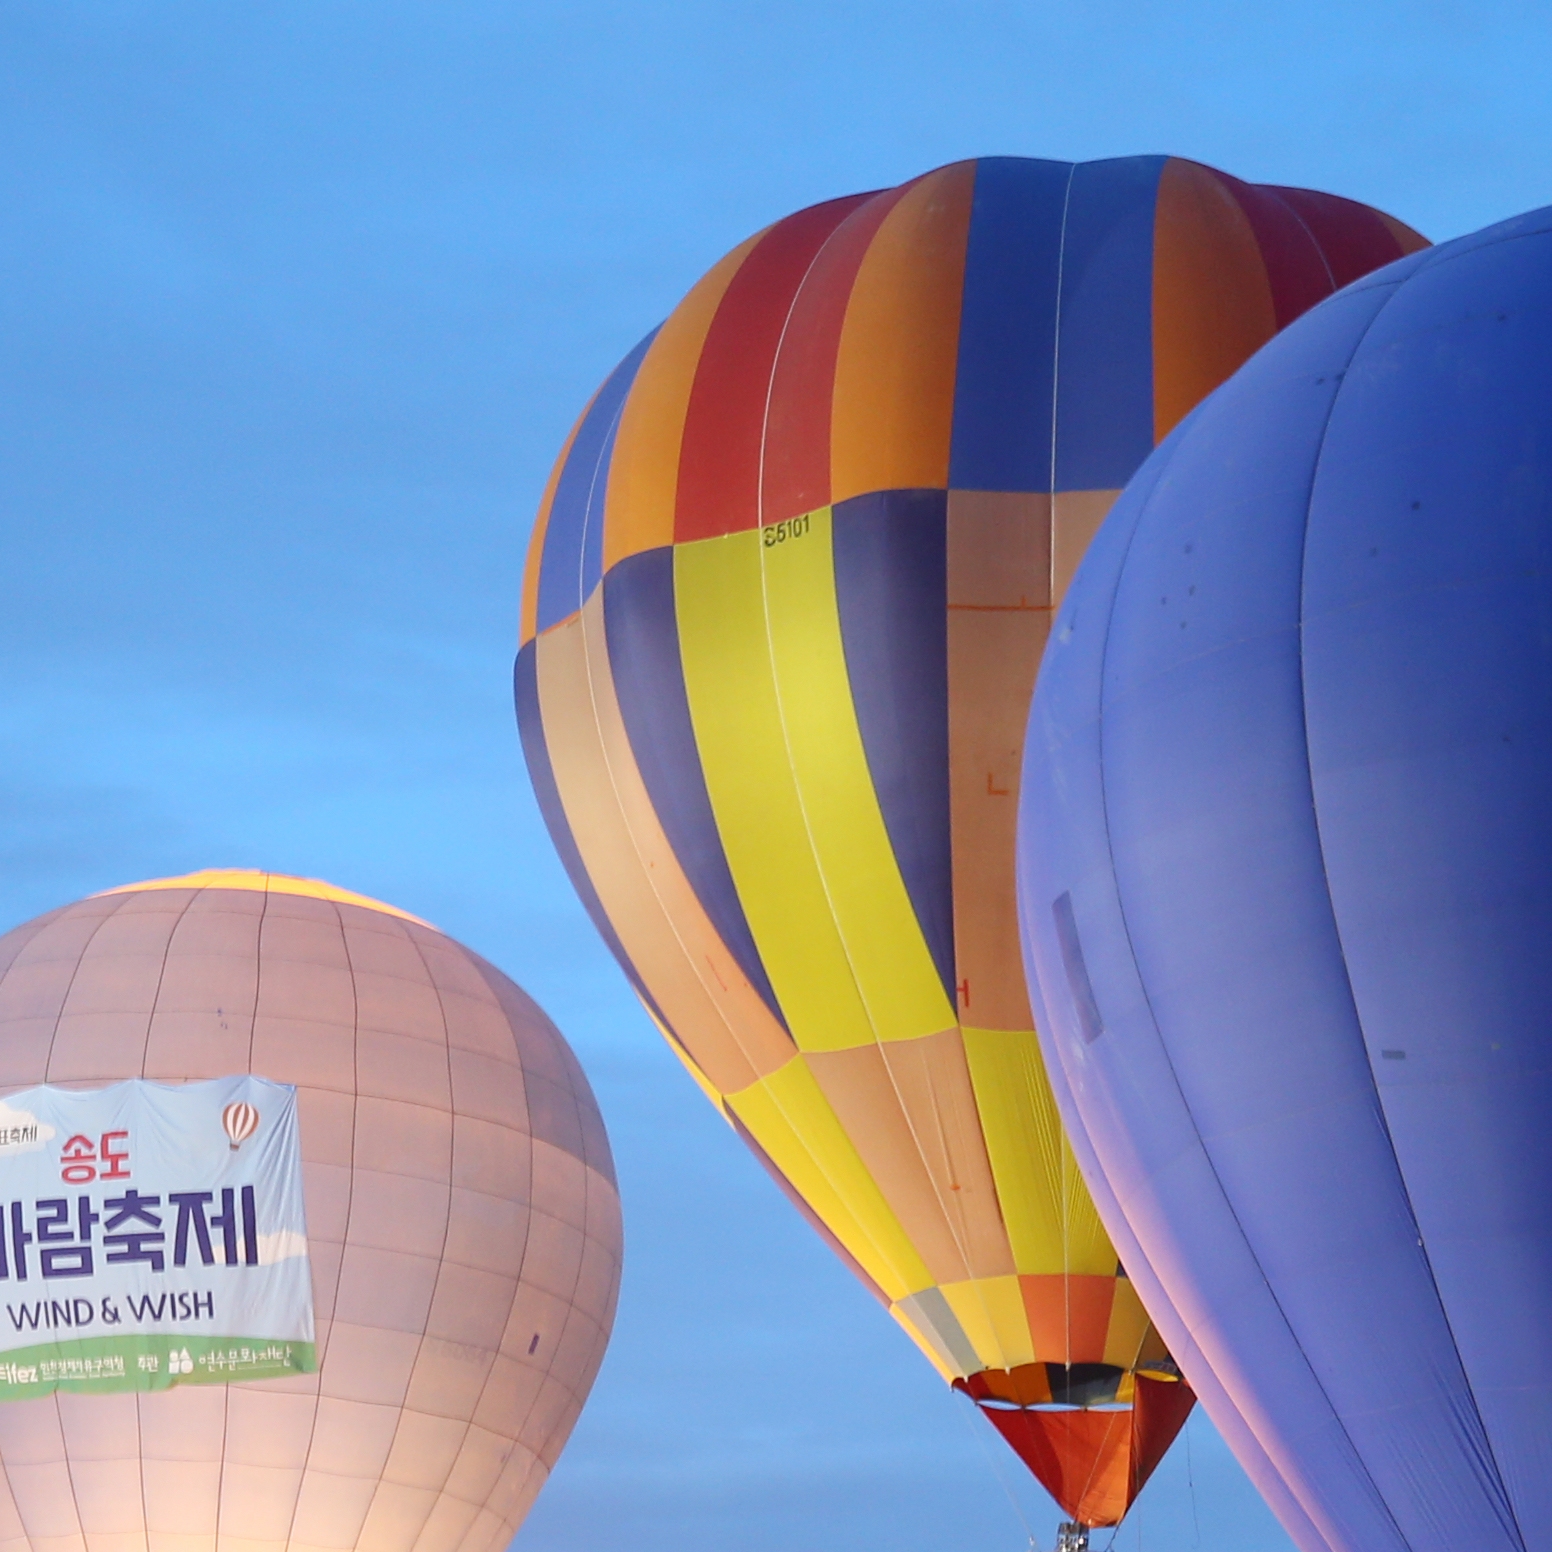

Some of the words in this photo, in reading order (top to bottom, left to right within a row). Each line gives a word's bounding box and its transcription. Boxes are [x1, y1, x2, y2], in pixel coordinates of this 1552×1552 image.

[764, 514, 810, 547] S5101
[60, 1130, 130, 1184] 송도
[6, 1299, 94, 1332] WIND
[100, 1296, 121, 1326] &
[127, 1290, 214, 1323] WISH
[138, 1354, 160, 1372] 주관
[199, 1344, 291, 1372] 연수문화재단
